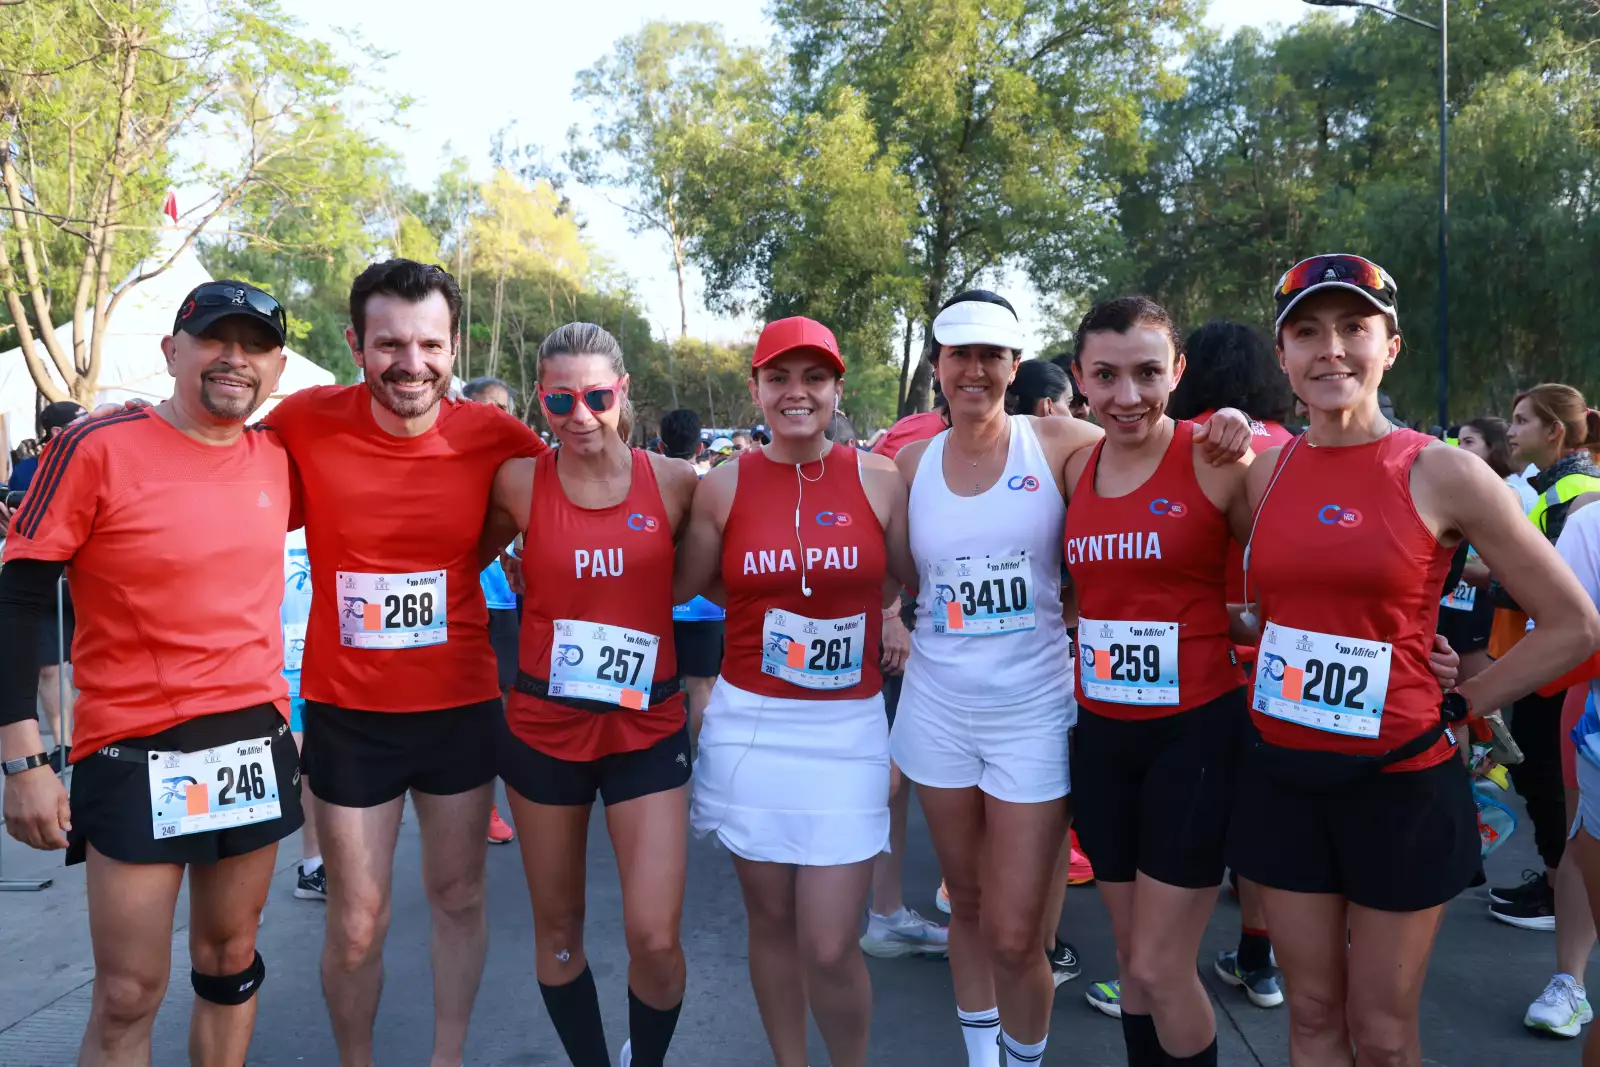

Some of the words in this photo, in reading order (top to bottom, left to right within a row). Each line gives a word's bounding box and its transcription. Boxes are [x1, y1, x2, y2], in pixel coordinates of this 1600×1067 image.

[575, 547, 624, 579] PAU
[743, 549, 797, 576] ANA
[806, 546, 858, 570] PAU
[1067, 531, 1162, 565] CYNTHIA
[385, 592, 433, 629] 268
[960, 577, 1028, 616] 3410
[1143, 628, 1166, 636] Mifel
[596, 645, 645, 686] 257
[808, 636, 852, 671] 261
[1109, 643, 1160, 683] 259
[1351, 646, 1379, 659] Mifel
[1303, 658, 1369, 710] 202
[216, 761, 266, 806] 246
